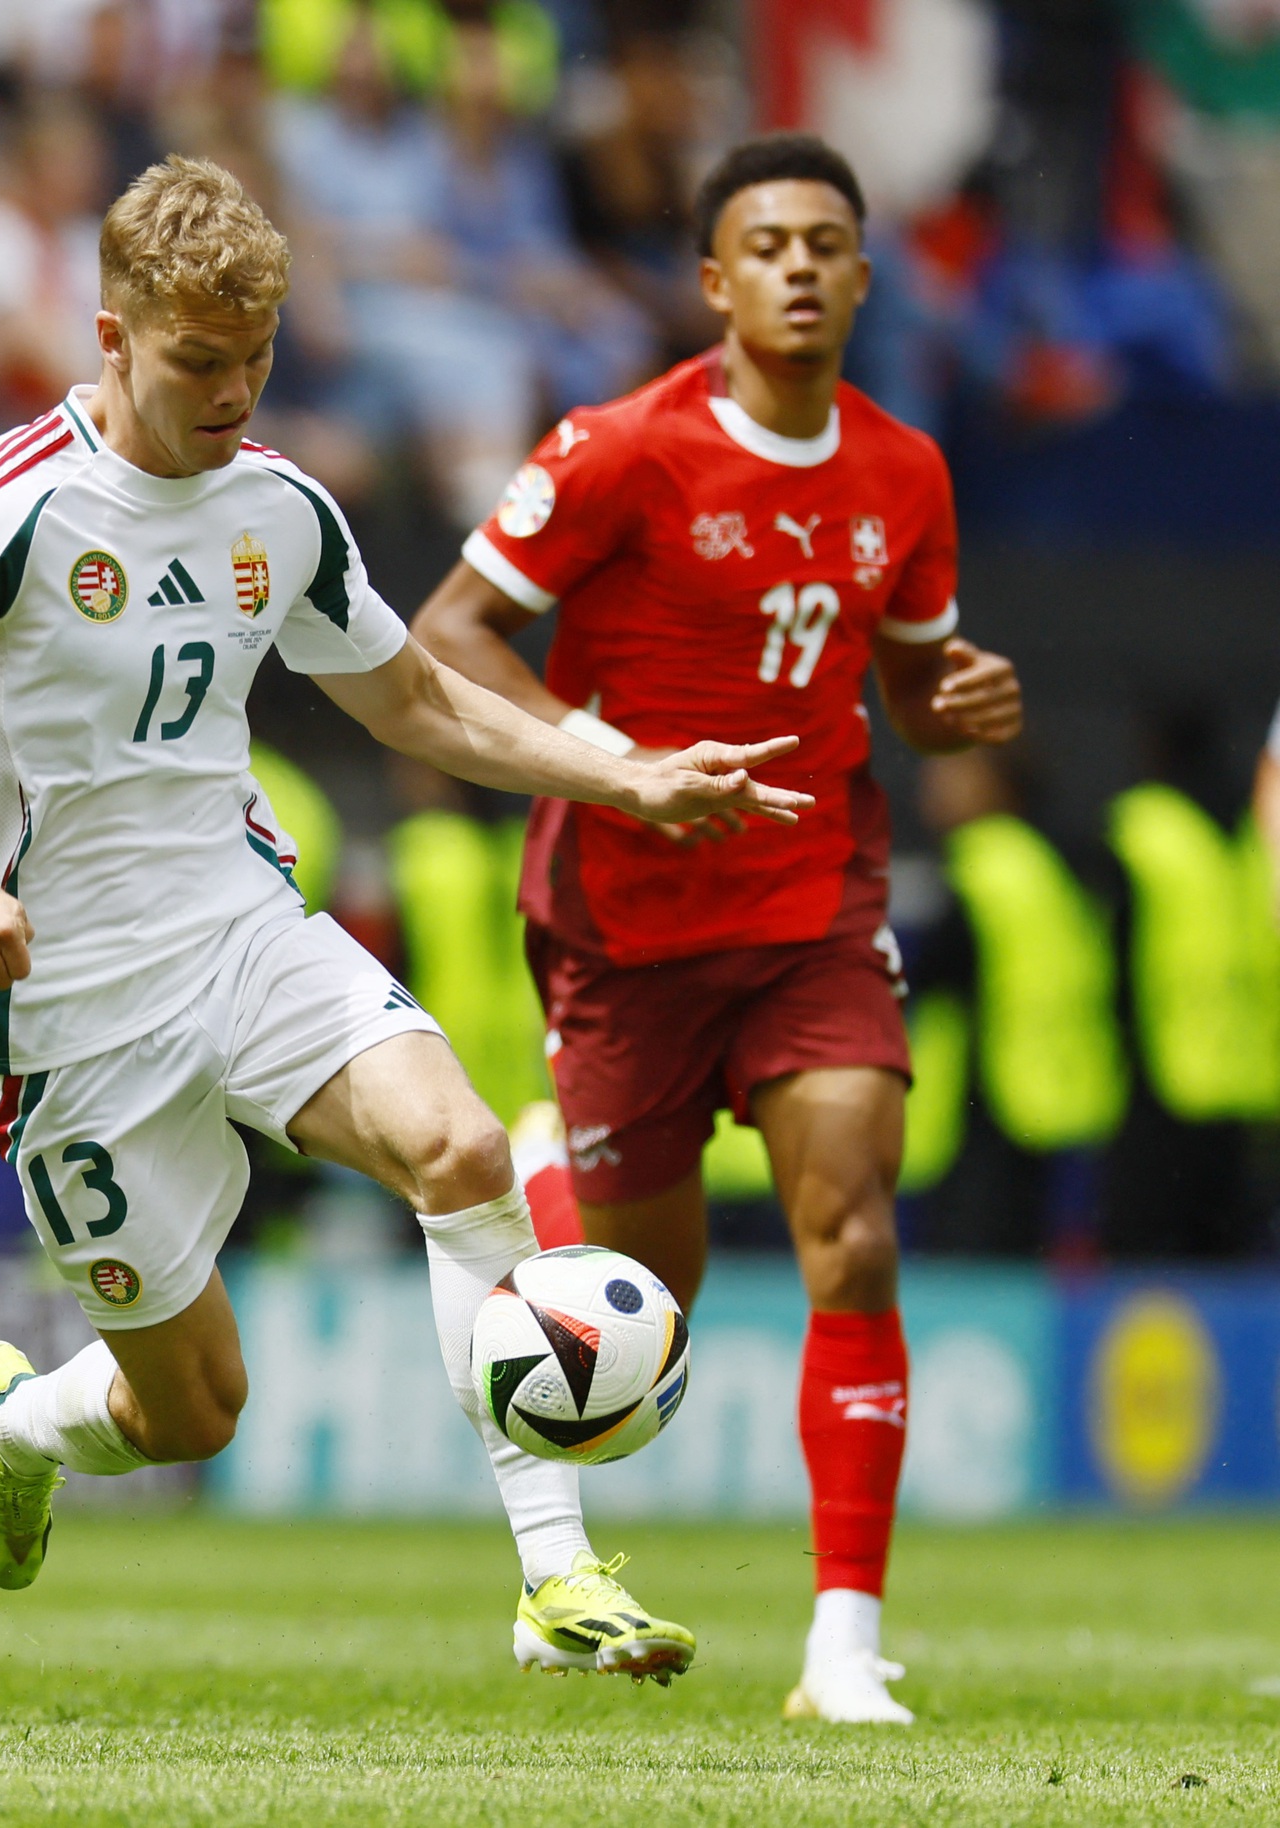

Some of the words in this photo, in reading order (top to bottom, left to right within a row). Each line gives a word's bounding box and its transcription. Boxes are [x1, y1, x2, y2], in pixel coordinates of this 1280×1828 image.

[758, 580, 840, 688] 19
[132, 640, 215, 743] 13
[28, 1140, 128, 1246] 13
